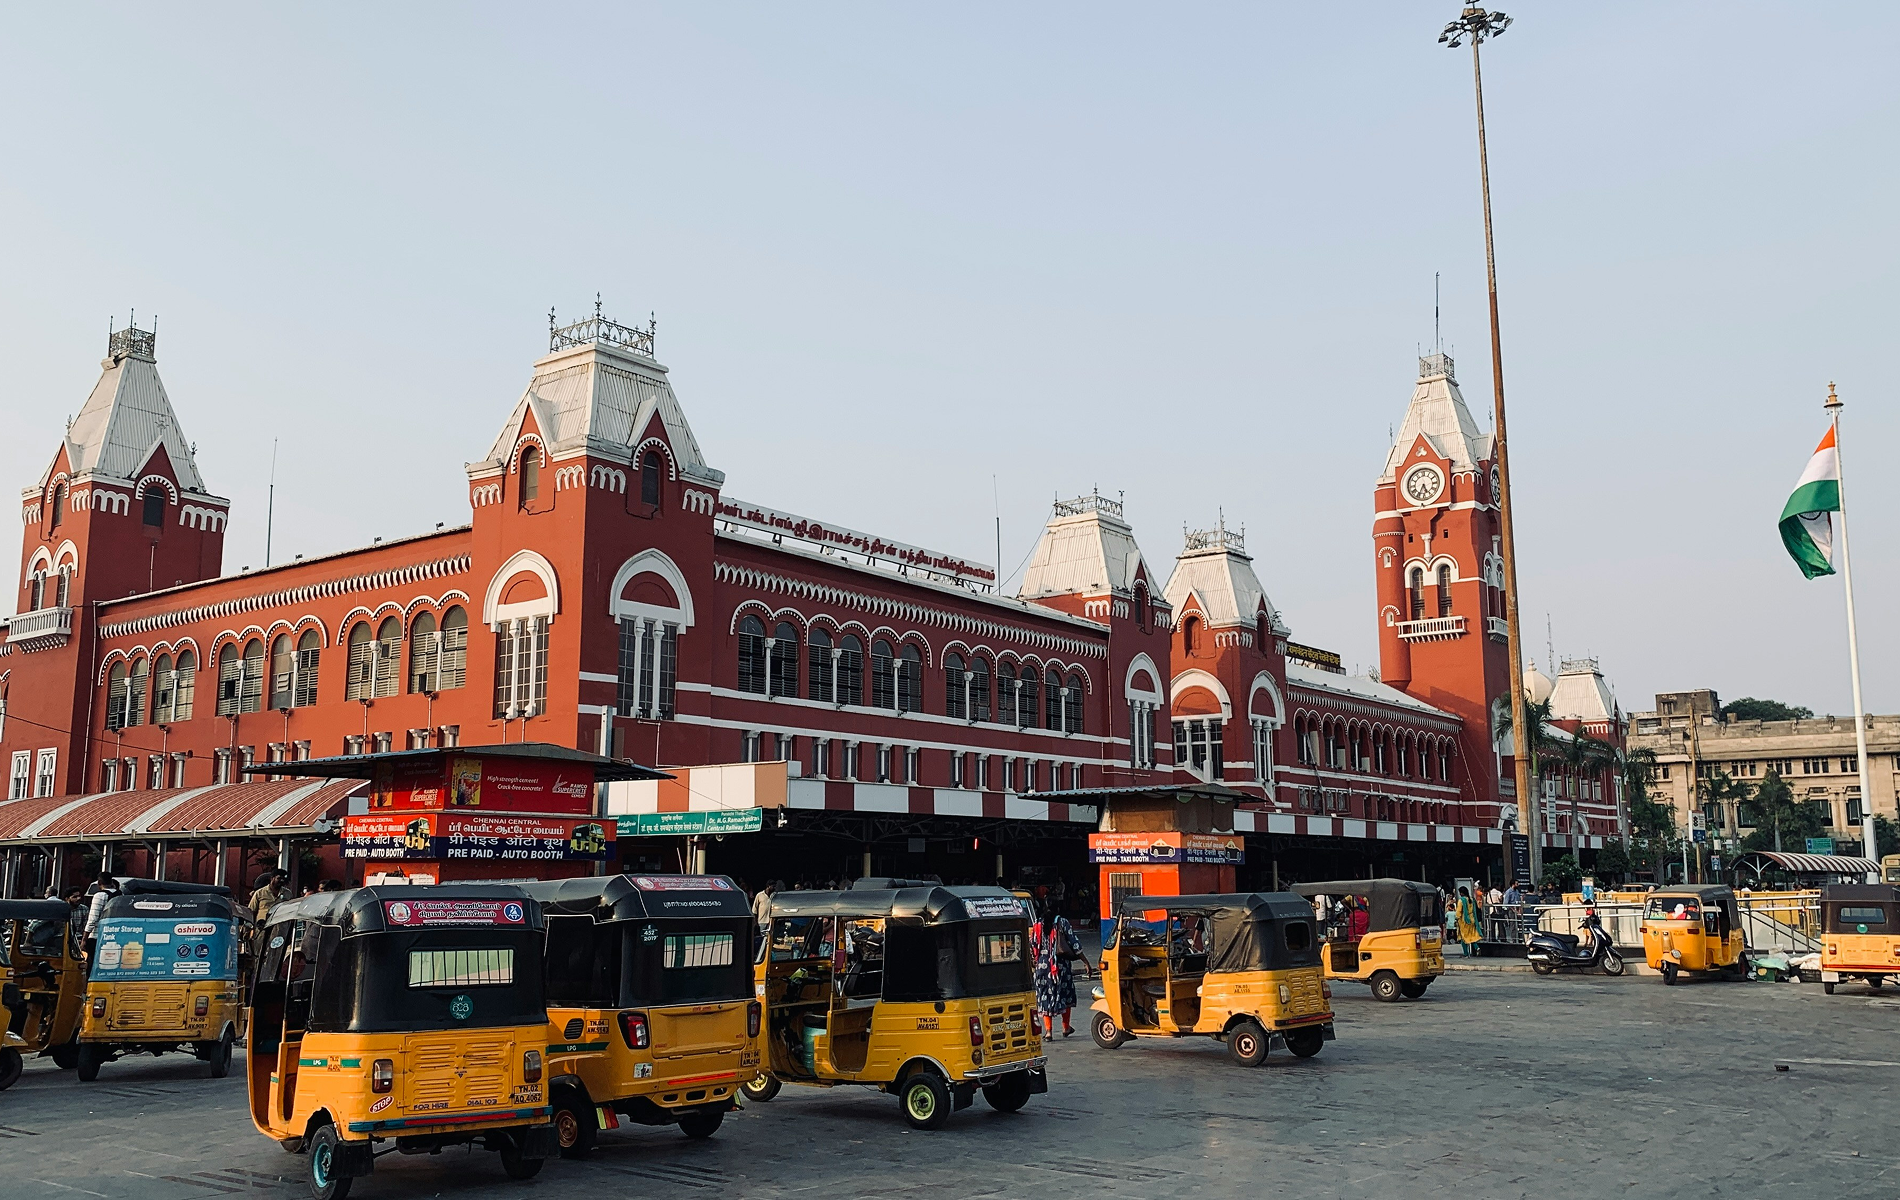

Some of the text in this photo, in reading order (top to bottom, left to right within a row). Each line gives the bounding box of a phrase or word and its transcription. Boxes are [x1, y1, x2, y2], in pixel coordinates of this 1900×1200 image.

[494, 825, 531, 834] ஆட்டோ
[533, 825, 565, 835] மையம்
[373, 833, 390, 844] ऑटो
[505, 834, 538, 847] ऑटो
[543, 837, 565, 850] बूथ
[345, 849, 355, 857] PRE
[355, 849, 368, 857] PAID
[370, 849, 385, 857] AUTO
[386, 848, 404, 858] BOOTH
[448, 849, 468, 858] PRE
[470, 849, 494, 858] PAID
[501, 850, 528, 859] AUTO
[530, 851, 564, 859] BOOTH
[121, 926, 143, 934] Storage
[177, 926, 214, 934] ashirvad
[518, 1085, 539, 1093] TN.02
[371, 1097, 392, 1112] STOP
